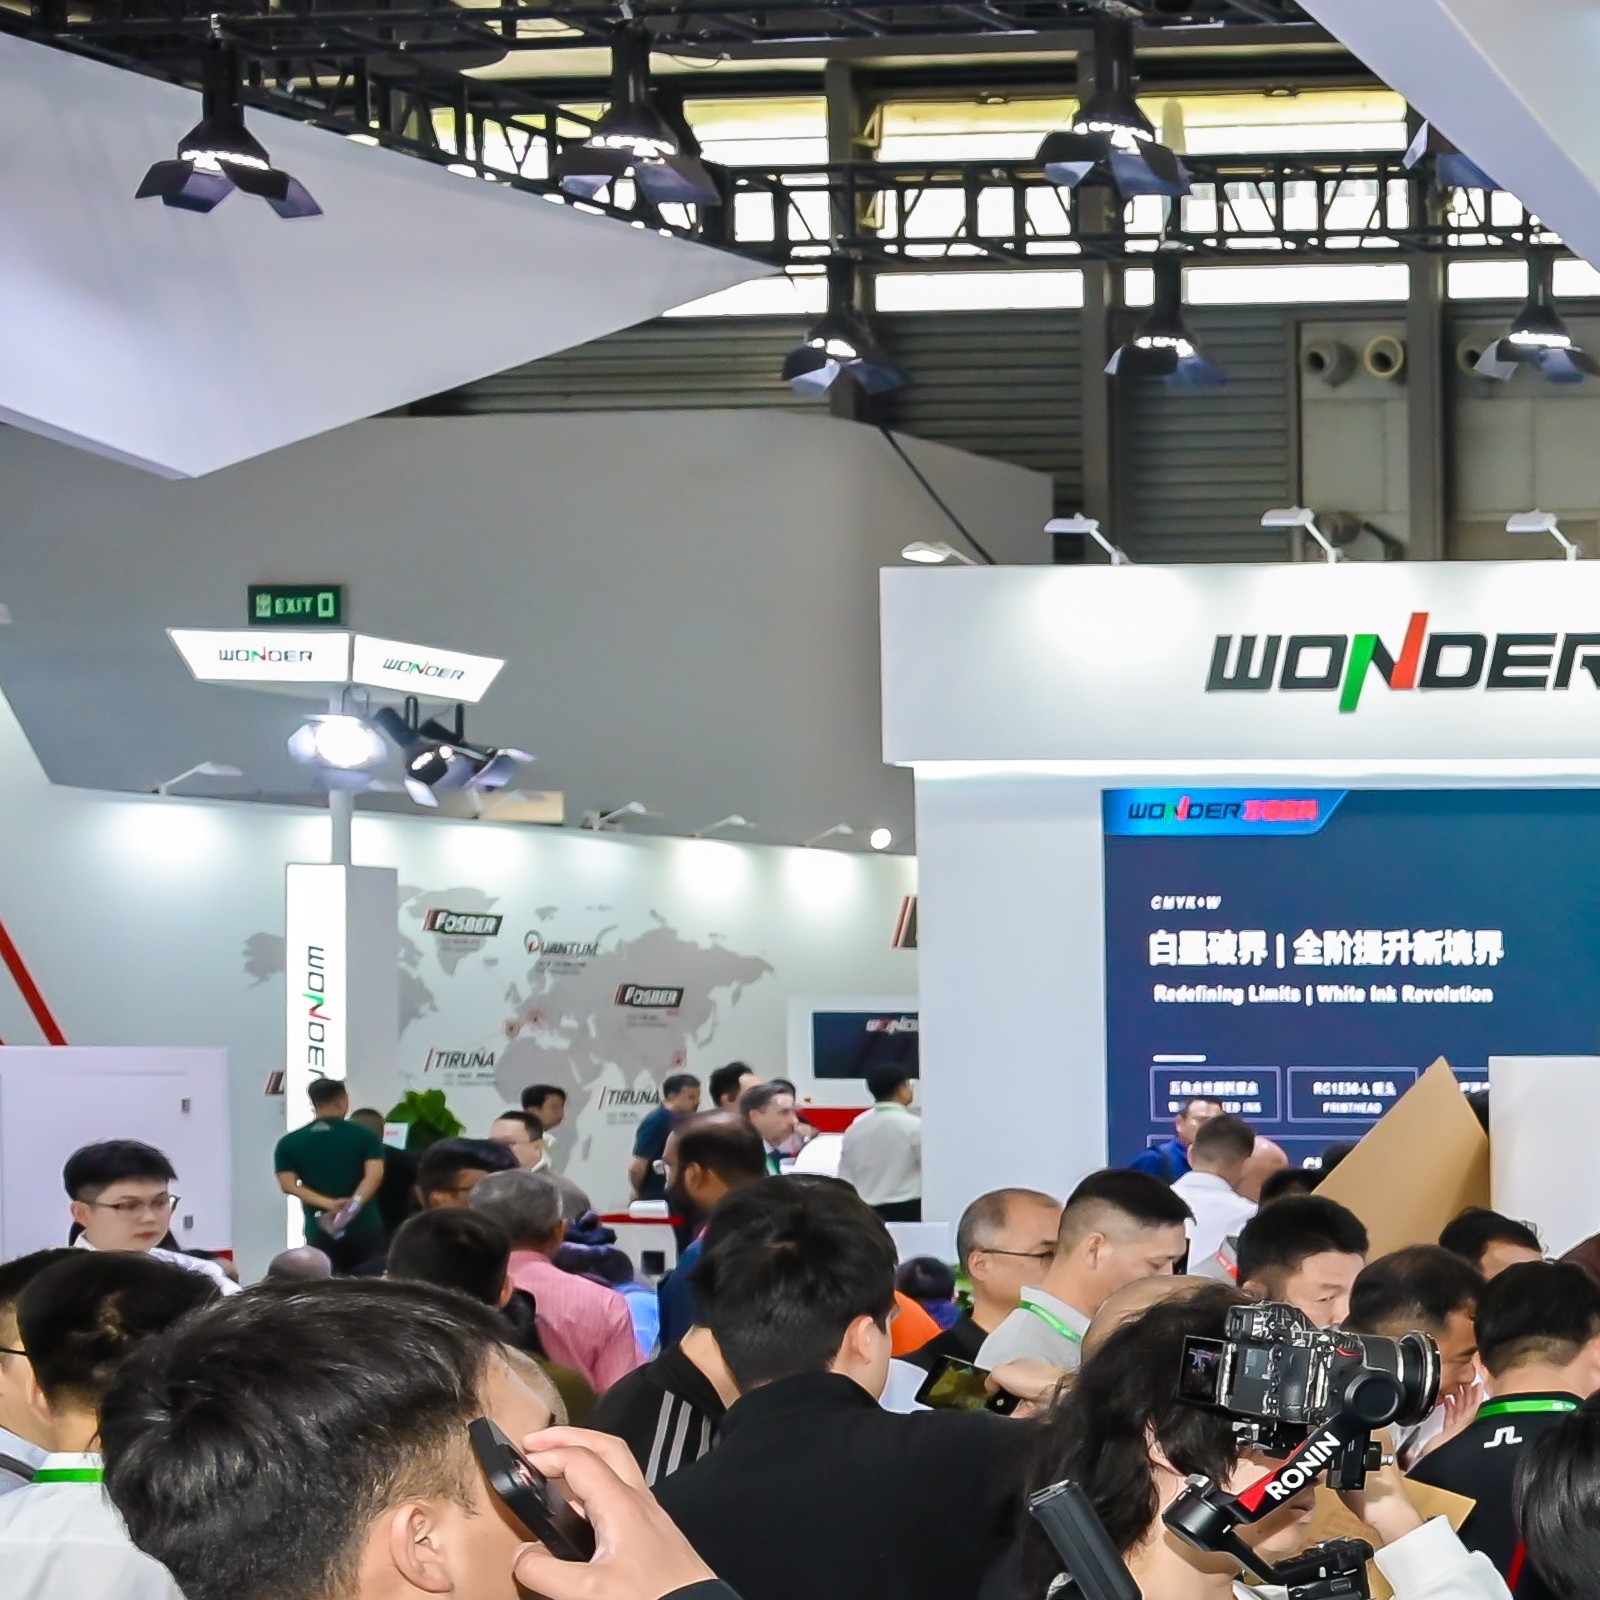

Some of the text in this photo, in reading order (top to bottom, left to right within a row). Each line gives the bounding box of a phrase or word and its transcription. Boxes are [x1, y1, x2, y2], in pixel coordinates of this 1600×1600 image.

[275, 597, 313, 614] EXIT
[219, 647, 312, 662] WONDER
[383, 659, 465, 680] WONDER
[1128, 796, 1241, 824] WONDER
[1153, 985, 1494, 1006] Redefining Limits White Ink Revolution
[1265, 1431, 1341, 1500] RONIN
